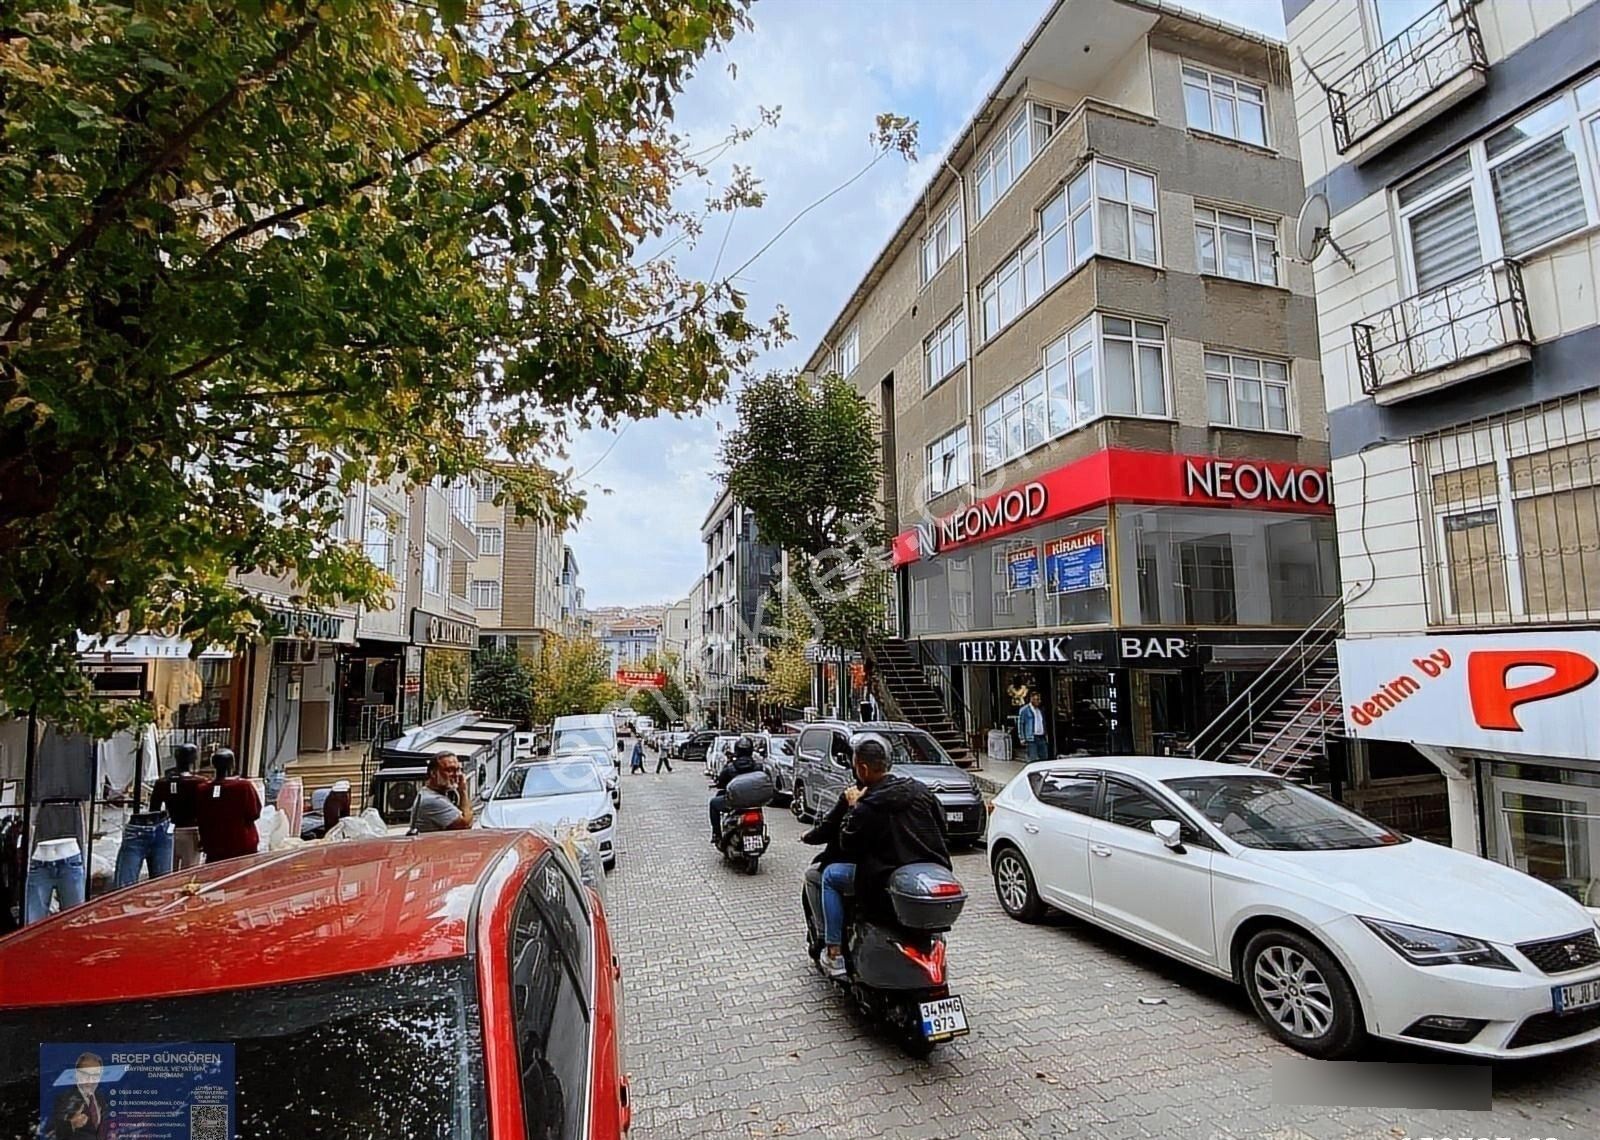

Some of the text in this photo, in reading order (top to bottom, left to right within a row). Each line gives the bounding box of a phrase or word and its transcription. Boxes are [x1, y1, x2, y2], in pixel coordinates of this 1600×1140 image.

[941, 481, 1046, 545] NEOMOD
[1052, 534, 1096, 556] KİRALIK
[144, 646, 181, 656] LIFE
[958, 640, 997, 662] THE
[1121, 637, 1190, 659] BAR
[1350, 647, 1453, 726] denim by
[1467, 649, 1599, 732] P
[1562, 987, 1576, 1008] 34
[922, 1004, 938, 1018] 34
[933, 1016, 956, 1032] 973
